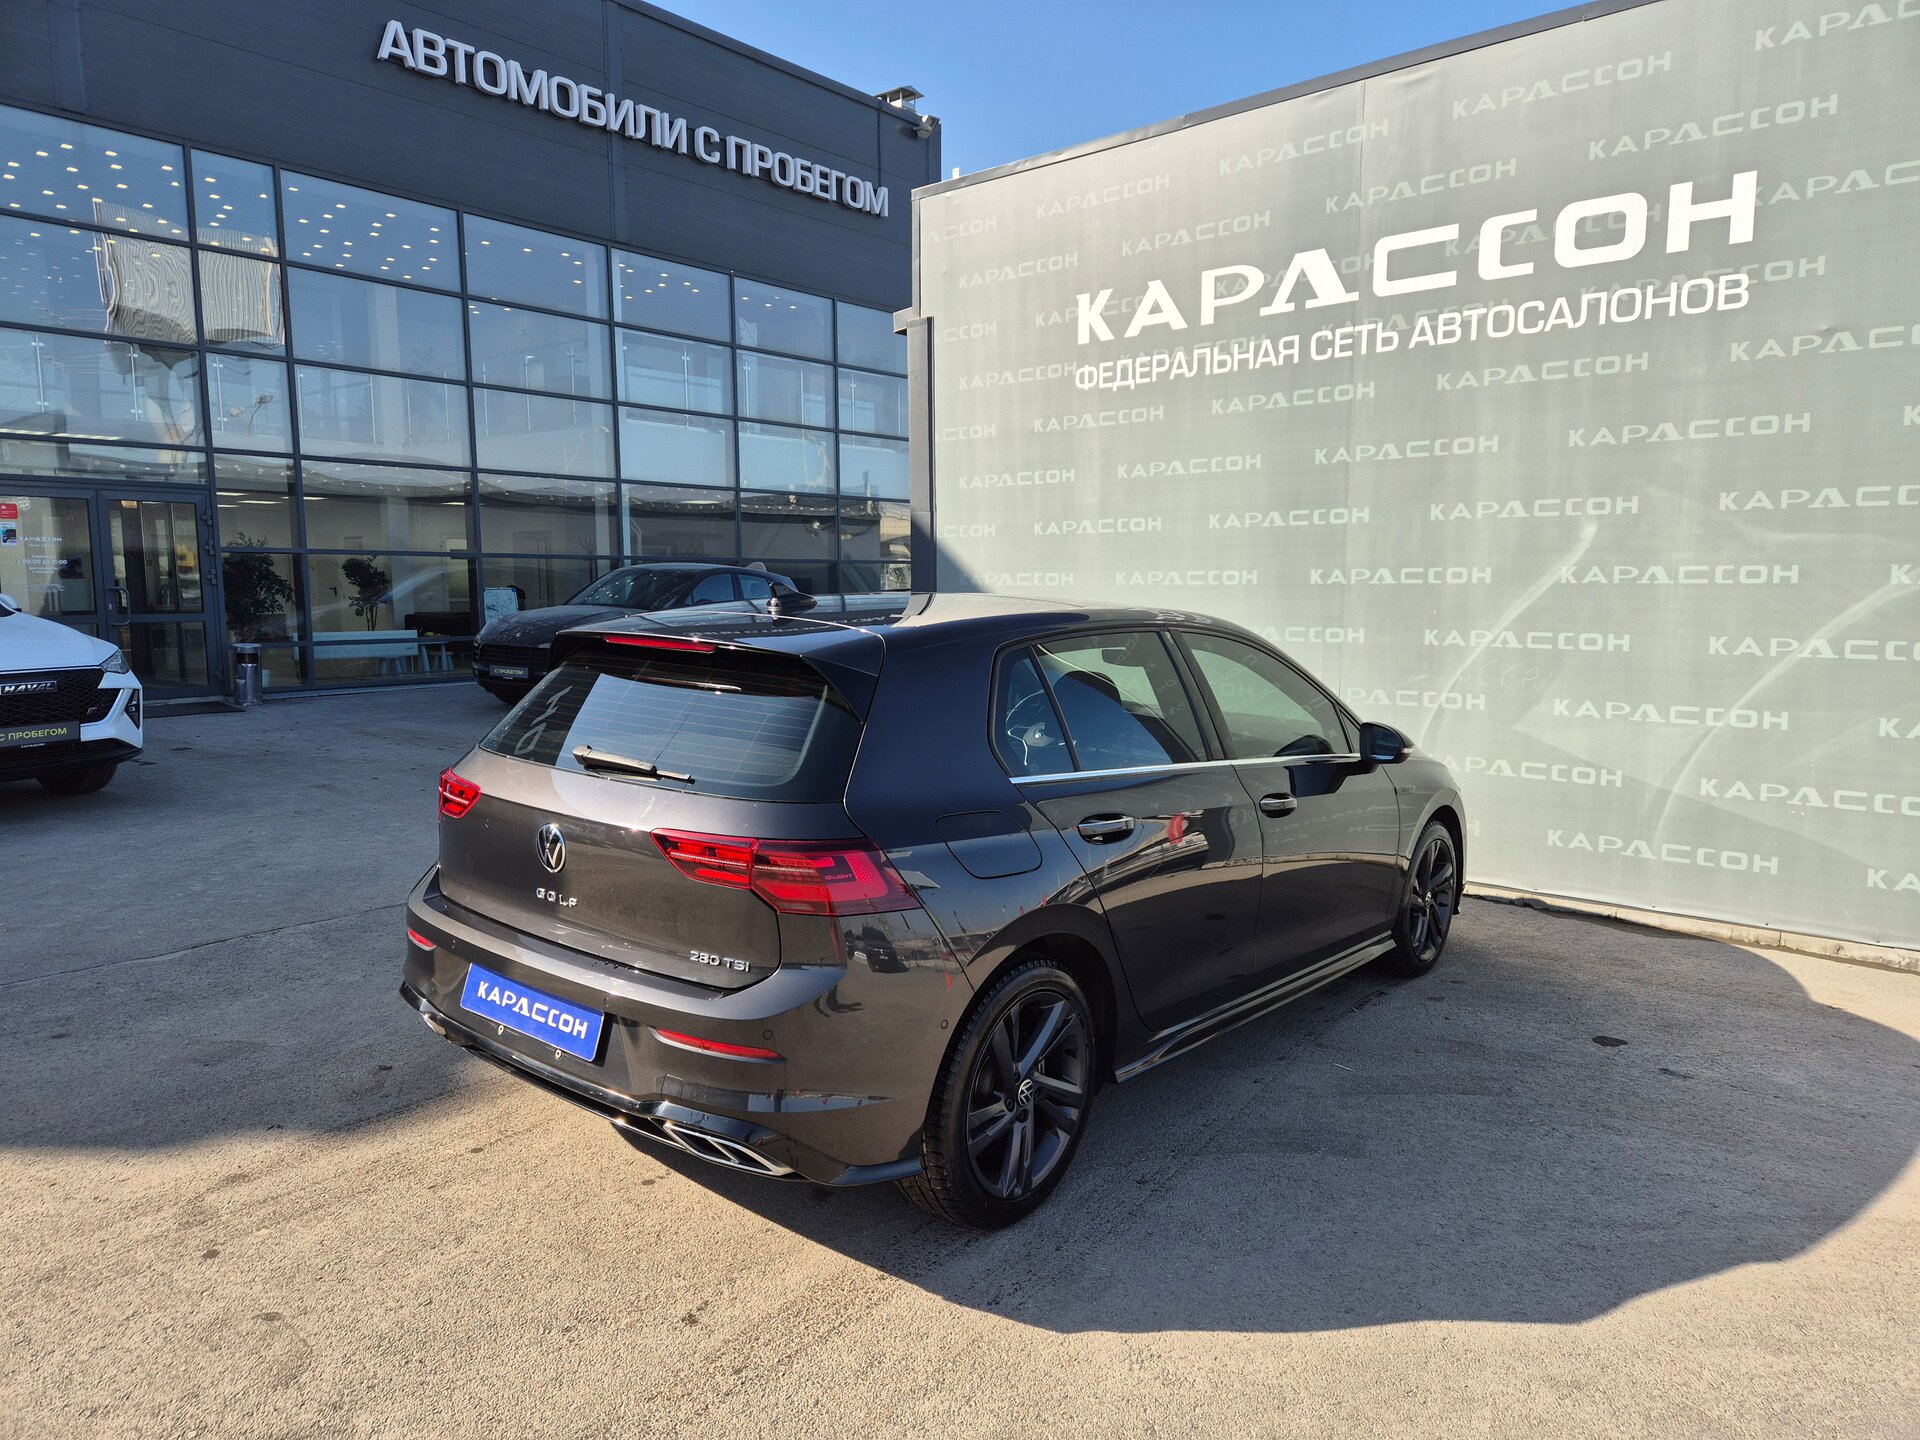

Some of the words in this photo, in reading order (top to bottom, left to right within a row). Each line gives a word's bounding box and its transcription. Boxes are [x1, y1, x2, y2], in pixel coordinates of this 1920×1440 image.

[1453, 51, 1672, 120] КАРАССОН
[376, 19, 688, 154] АВТОМОБИЛИ
[694, 126, 721, 164] С
[726, 135, 889, 218] ПРОБЕГОМ
[1589, 93, 1839, 161] КАРАССОН
[1219, 118, 1389, 176] КАРАССОН
[1036, 174, 1170, 219] КАРАССОН
[1325, 158, 1517, 214] КАРАССОН
[1122, 210, 1271, 257] КАРАССОН
[959, 251, 1078, 289] КАРАССОН
[1076, 170, 1758, 345] КАРАССОН
[936, 320, 997, 343] ССОН
[1075, 340, 1300, 392] ФЕДЕРАЛЬНАЯ
[1310, 323, 1399, 362] СЕТЬ
[1408, 273, 1750, 349] АВТОСАЛОНОВ
[959, 361, 1078, 391] КАРАССОН
[1436, 352, 1649, 392] КАРАССОН
[1211, 381, 1375, 415] КАРАССОН
[936, 424, 996, 441] ССОН
[1033, 405, 1165, 434] КАРАССОН
[1568, 412, 1811, 448] КАРАССОН
[1314, 435, 1499, 466] КАРАССОН
[959, 468, 1075, 489] КАРАССОН
[1117, 454, 1262, 480] КАРАССОН
[1209, 507, 1370, 530] КАРАССОН
[1430, 496, 1639, 521] КАРАССОН
[938, 523, 996, 538] ССОН
[1033, 516, 1163, 537] КАРАССОН
[1116, 569, 1258, 587] КАРАССОН
[1310, 567, 1492, 585] КАРАССОН
[1561, 564, 1799, 585] КАРАССОН
[1424, 629, 1631, 653] КАРАССОН
[1709, 636, 1920, 662] КАРАСС
[3, 682, 55, 693] HAVAL
[1553, 699, 1789, 731] КАРАССОН
[8, 727, 67, 740] ПРОБЕГОМ
[1441, 755, 1623, 788] АРАССОН
[1547, 829, 1779, 876] КАРАССОН
[536, 887, 578, 908] GOLF
[689, 950, 720, 966] 280
[723, 957, 750, 972] TSI
[476, 981, 588, 1040] КАРАССОН
